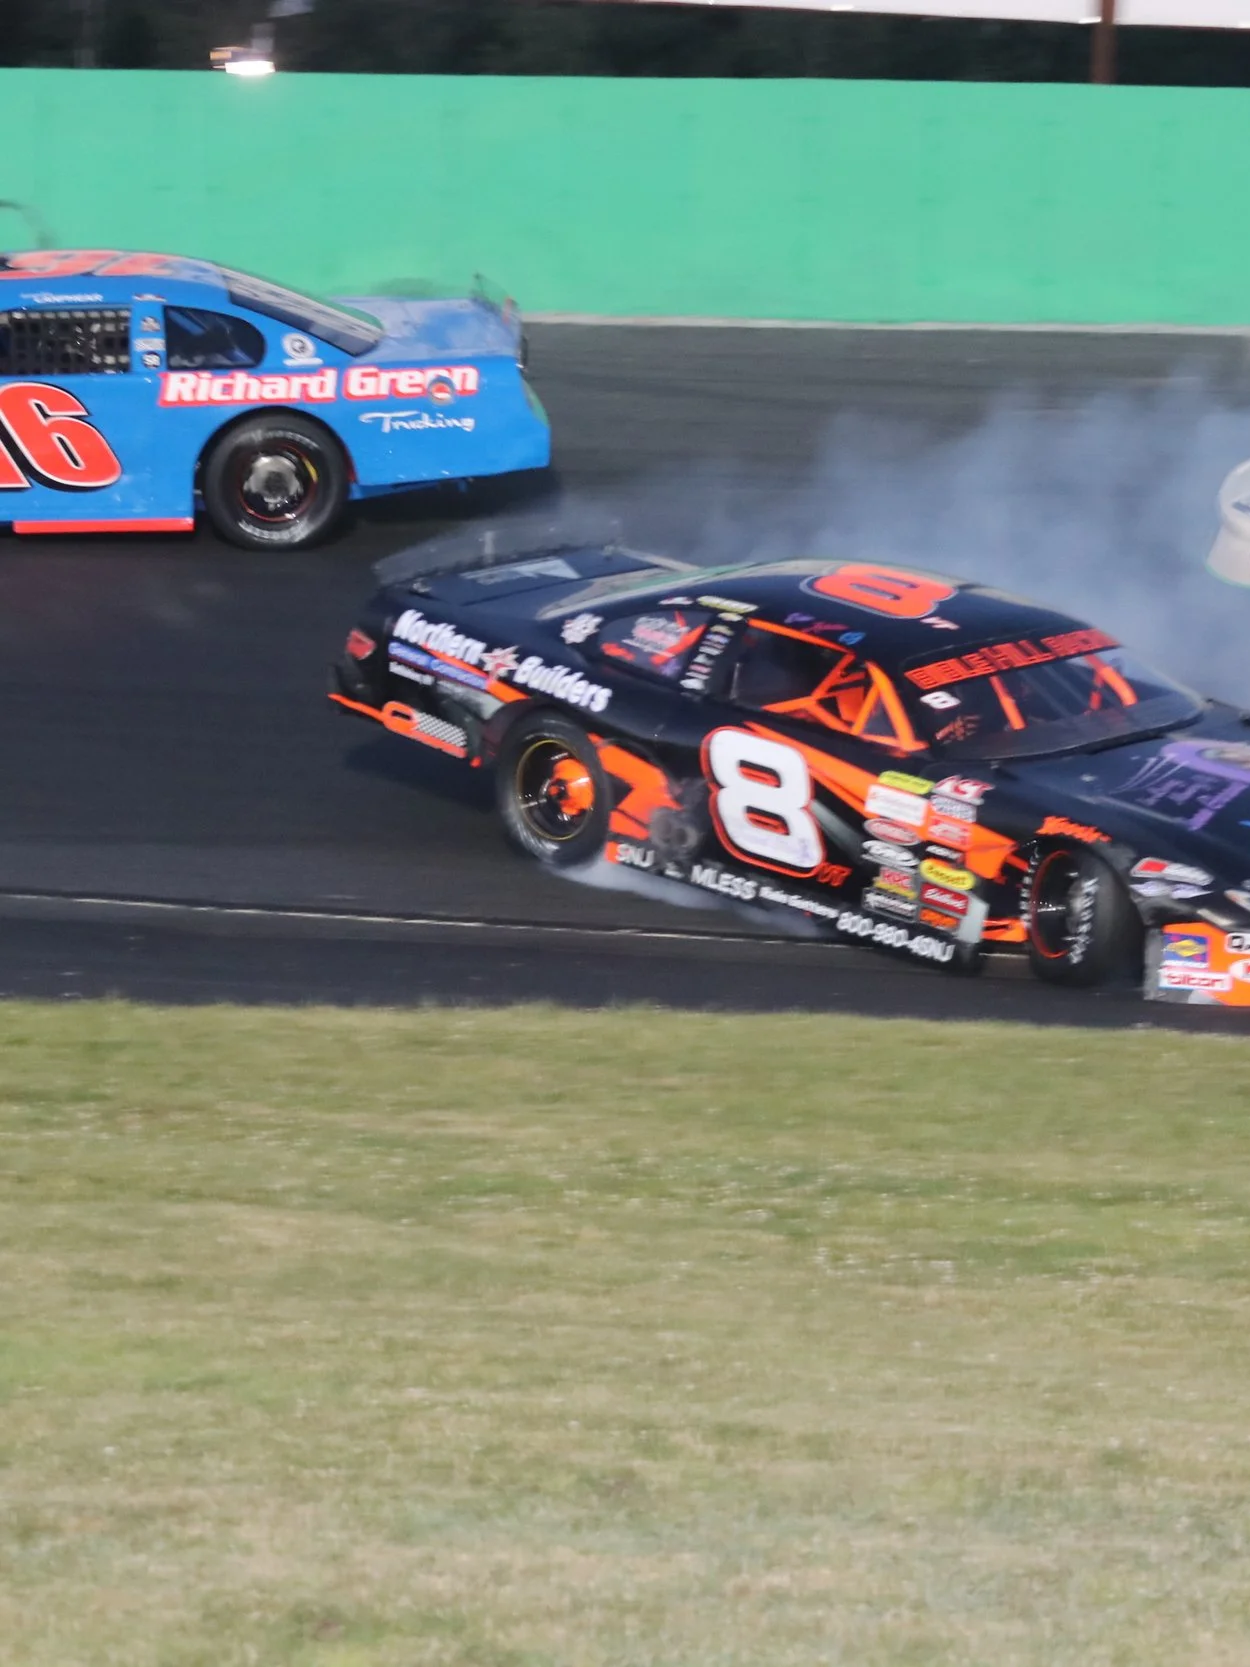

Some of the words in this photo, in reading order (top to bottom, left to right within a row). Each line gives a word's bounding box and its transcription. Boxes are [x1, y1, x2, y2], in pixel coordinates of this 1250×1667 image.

[161, 369, 337, 406] Richard
[393, 608, 487, 665] Northern
[513, 655, 612, 712] Builders
[702, 726, 826, 877] 8
